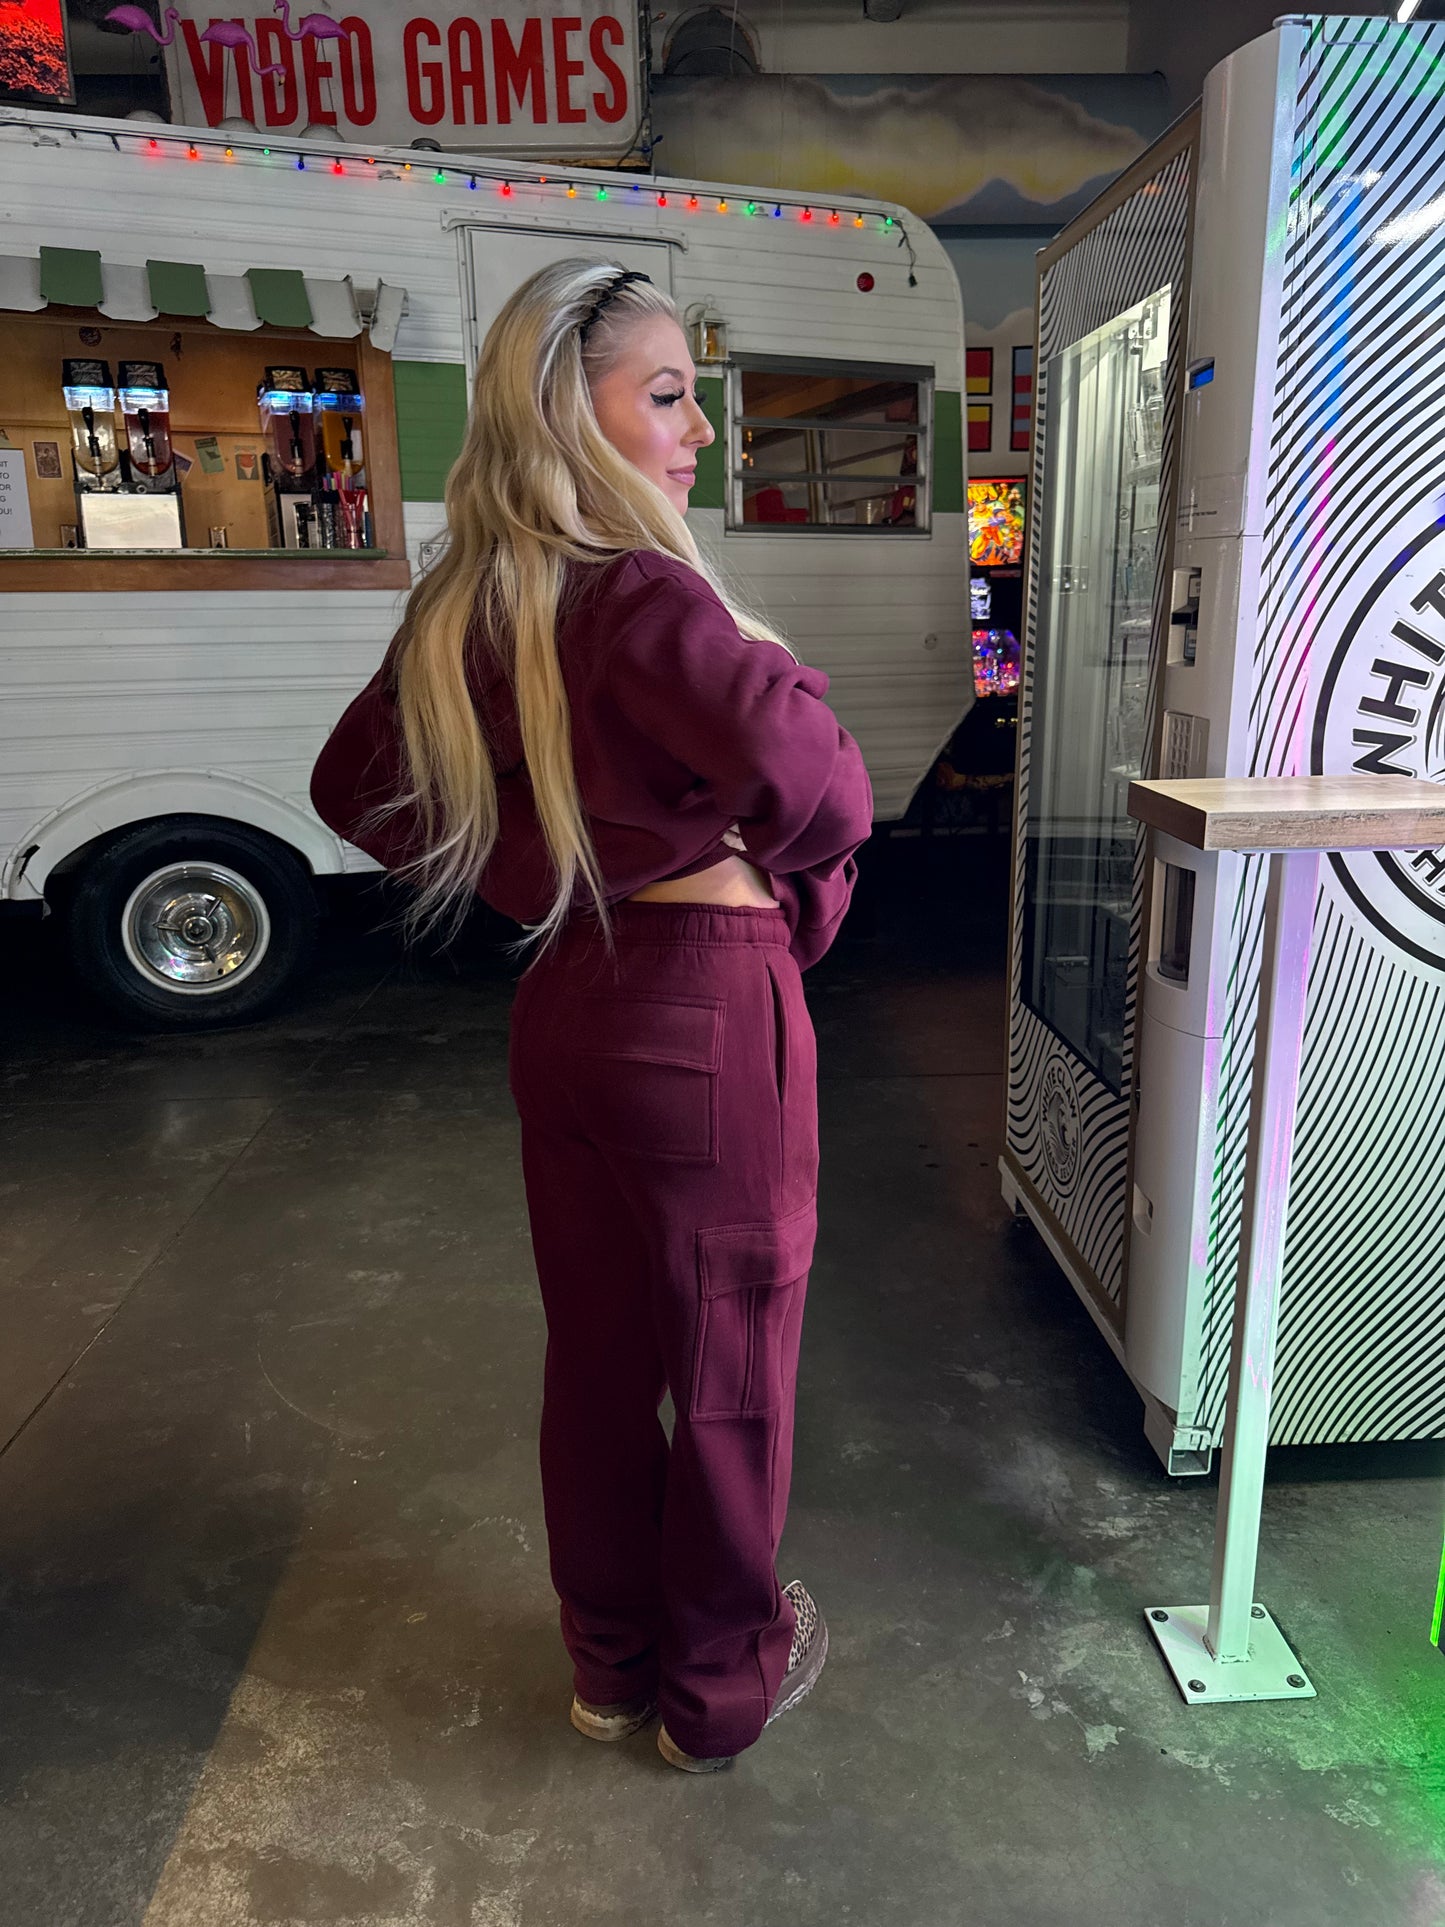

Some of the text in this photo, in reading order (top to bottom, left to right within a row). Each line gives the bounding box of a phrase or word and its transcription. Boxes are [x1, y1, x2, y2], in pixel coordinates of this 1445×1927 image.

[181, 15, 628, 127] VIDEO GAMES
[0, 460, 8, 468] IT
[1042, 1066, 1077, 1122] WHITE CLAW
